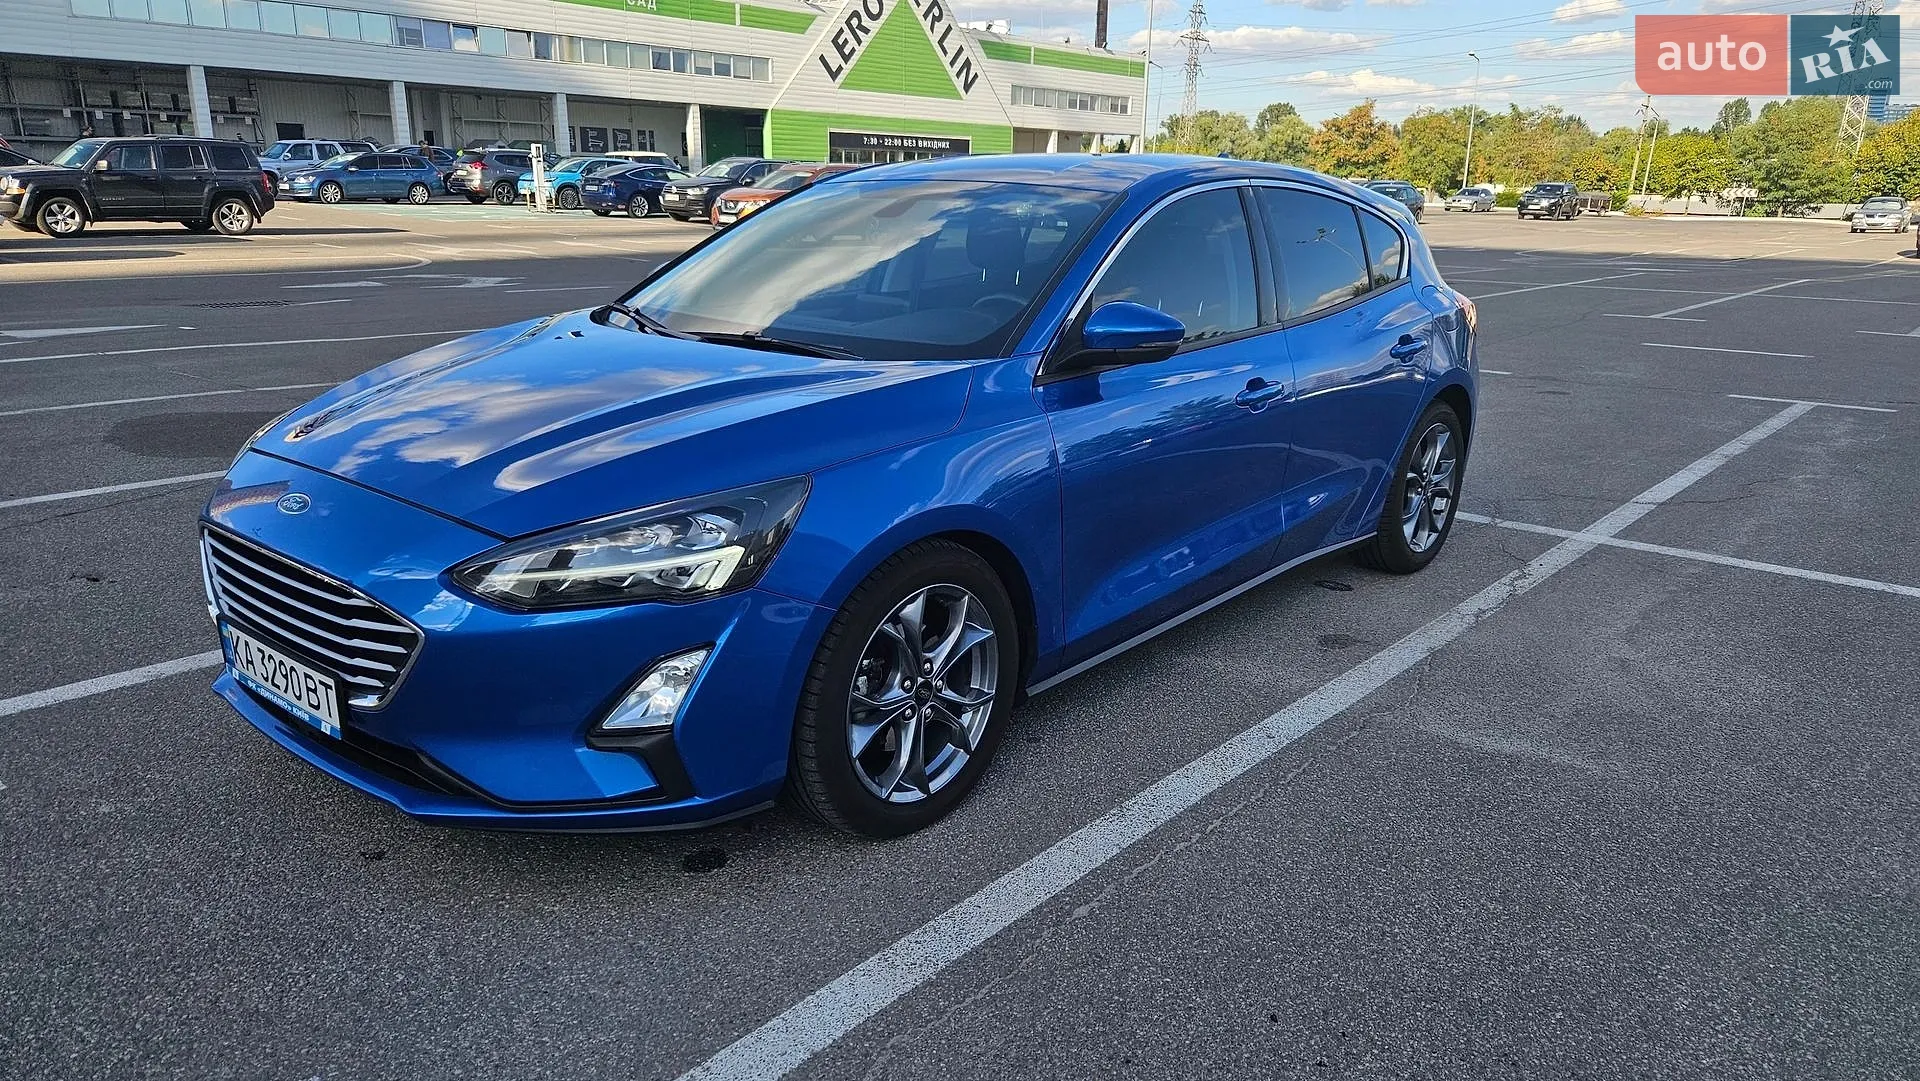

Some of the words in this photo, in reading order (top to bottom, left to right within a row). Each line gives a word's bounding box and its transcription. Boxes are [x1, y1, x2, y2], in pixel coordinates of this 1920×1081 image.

[863, 137, 878, 145] 7:30
[884, 138, 902, 147] 22:00
[903, 139, 917, 147] БЕЗ
[918, 140, 950, 150] ВИХІДНИХ
